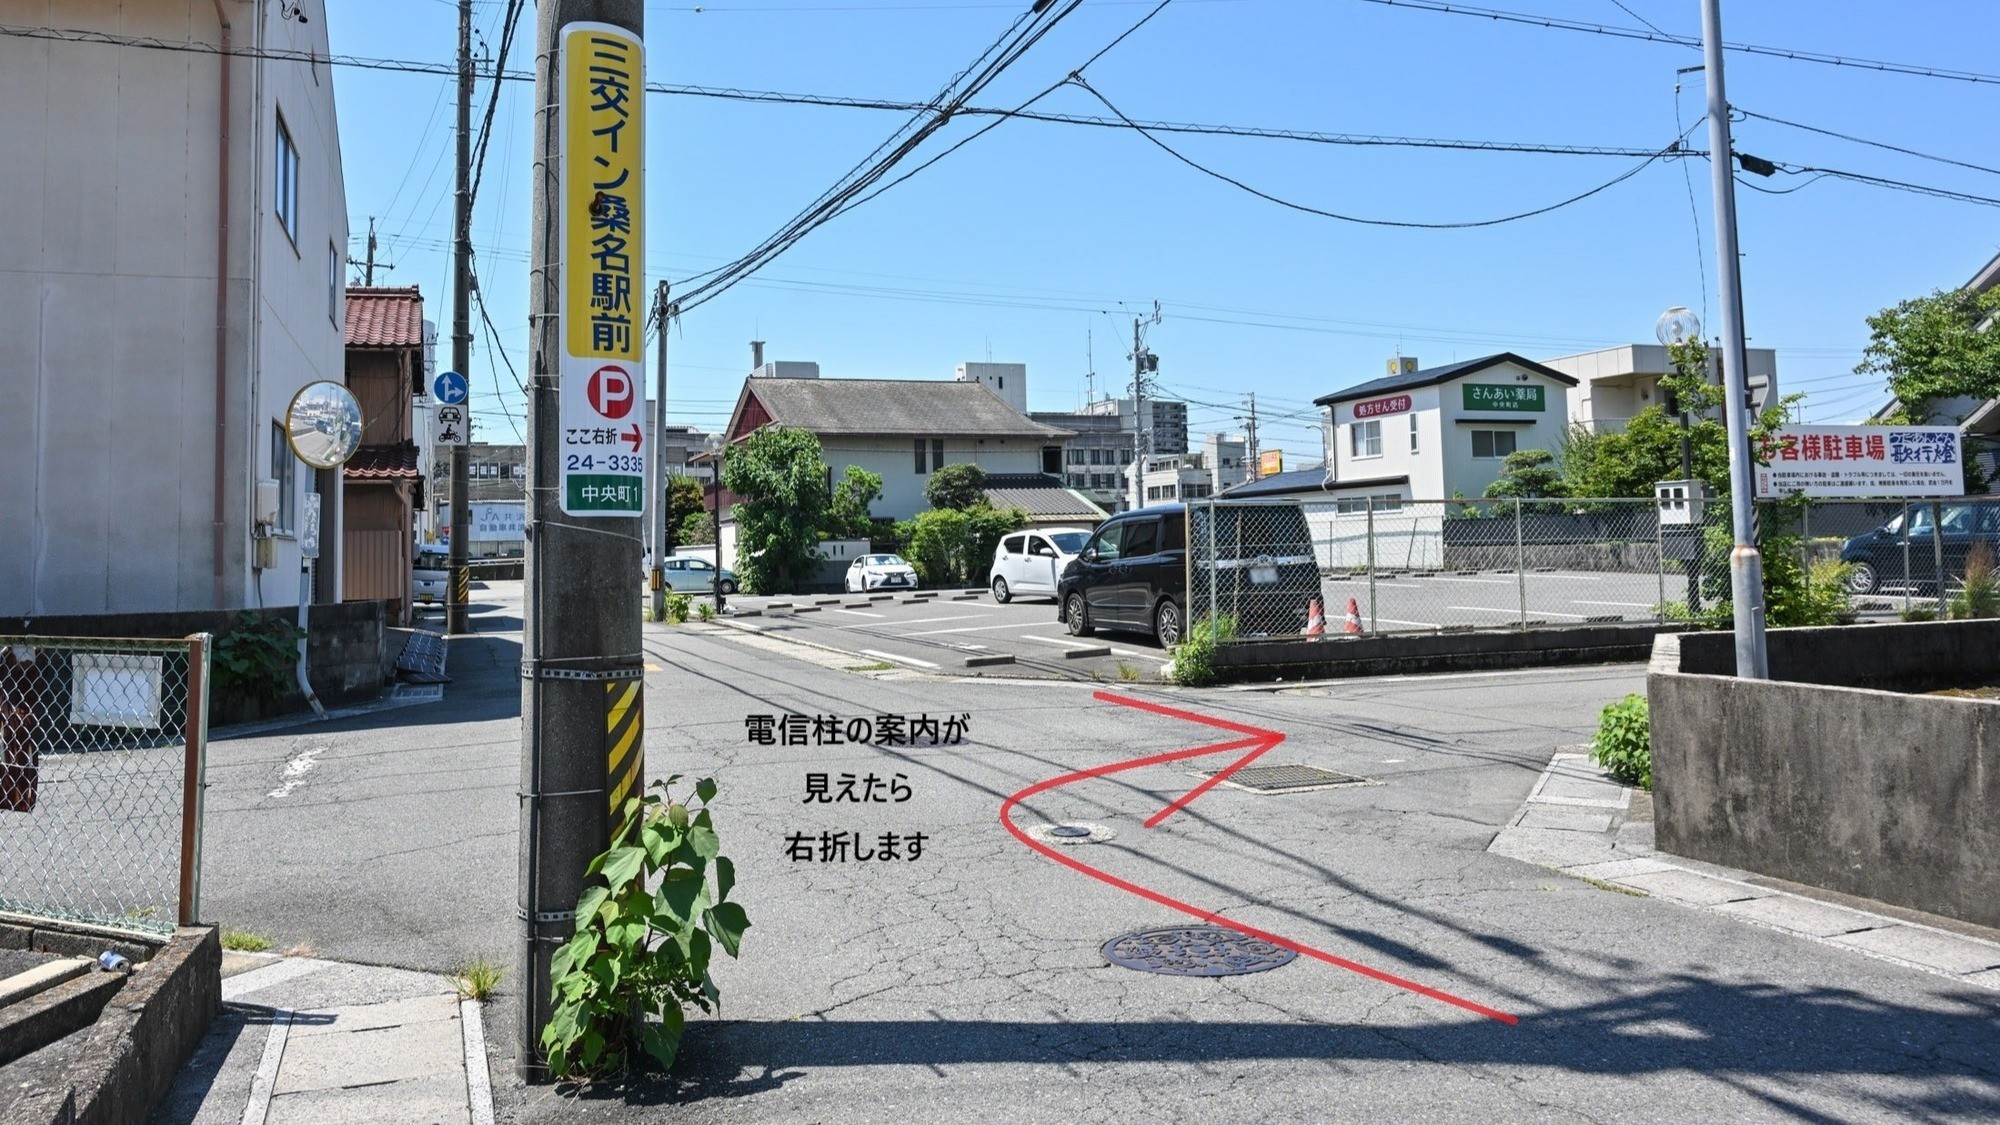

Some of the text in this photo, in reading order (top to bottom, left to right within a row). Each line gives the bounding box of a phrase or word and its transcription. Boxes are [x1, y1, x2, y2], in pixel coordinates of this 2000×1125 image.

[589, 37, 632, 354] 三交イン桑名駅前
[599, 371, 630, 414] P
[1472, 387, 1537, 401] さんあい薬局
[1359, 398, 1406, 416] 処方せん受付
[1492, 401, 1519, 409] 中央町店
[566, 427, 618, 445] ここ右折
[1761, 434, 1885, 462] お客様駐車場
[1890, 442, 1956, 464] 歌行燈
[567, 454, 643, 473] 24-3335
[581, 484, 638, 503] 中央町1
